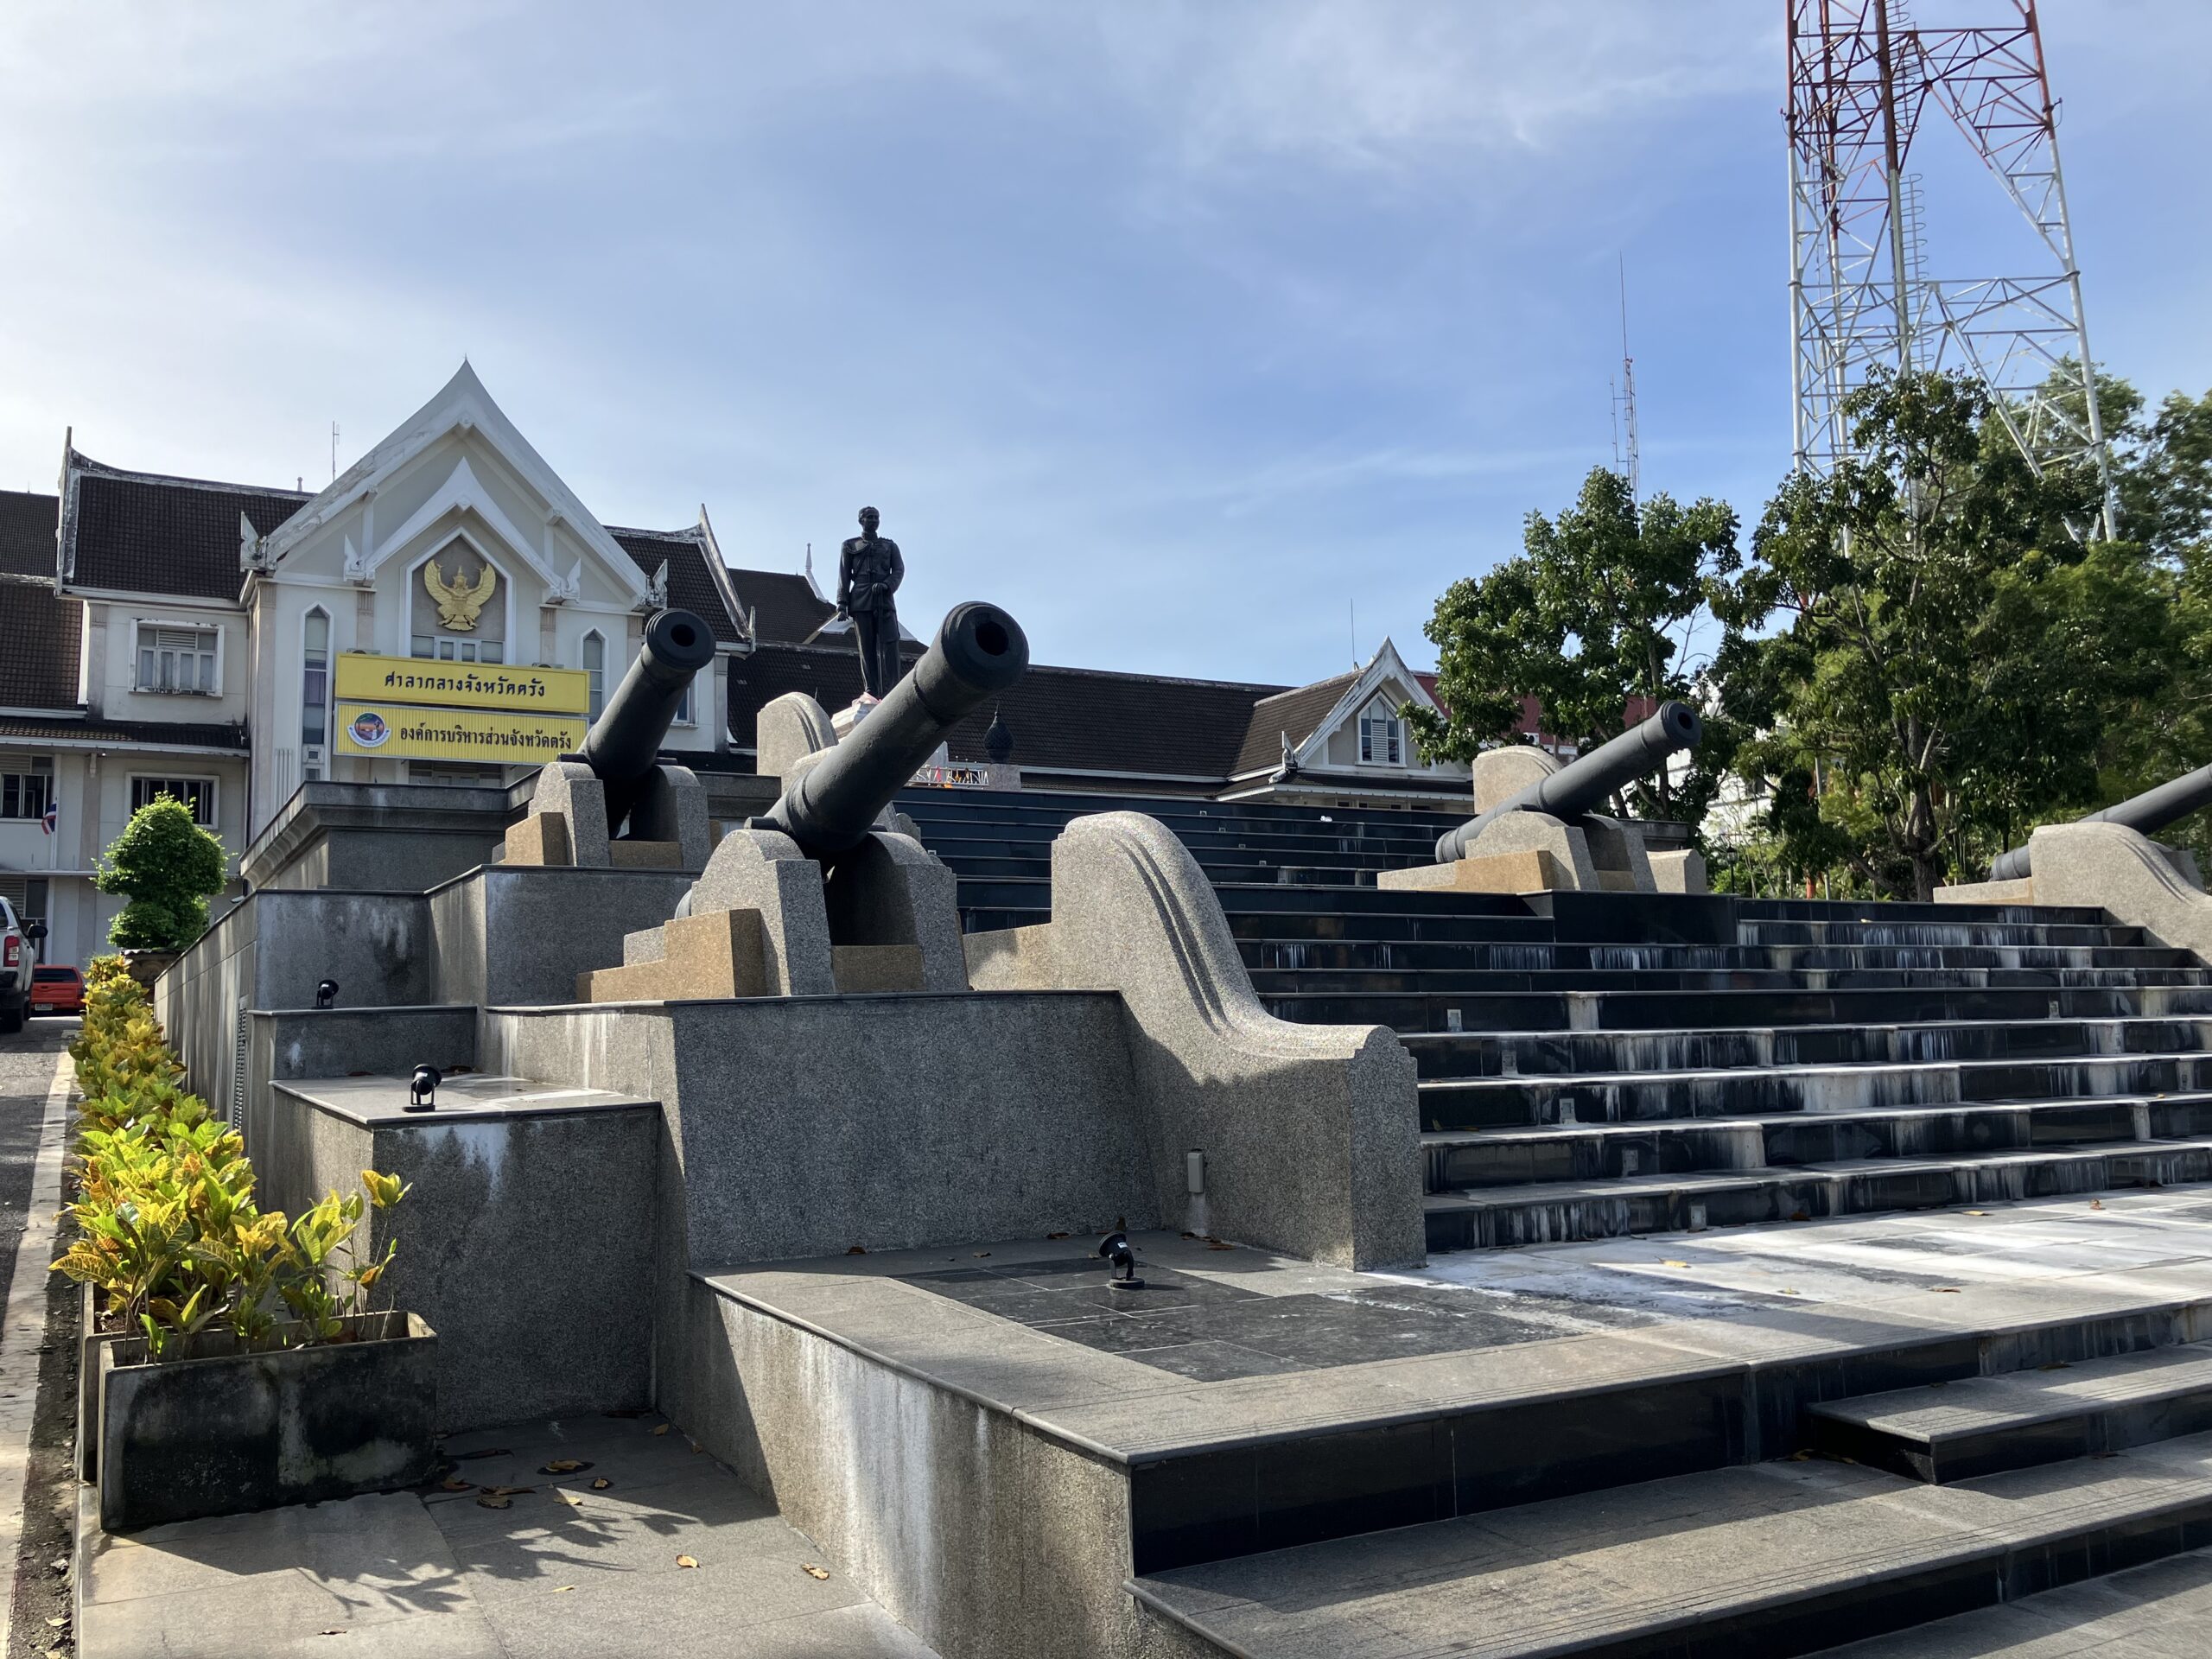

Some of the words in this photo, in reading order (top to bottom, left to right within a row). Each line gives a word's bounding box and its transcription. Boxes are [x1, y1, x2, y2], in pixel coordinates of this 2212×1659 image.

[385, 671, 545, 696] ศาลากลางจังหวัดตรัง
[400, 721, 571, 749] องค์การบริหารส่วนจังหวัดตรัง
